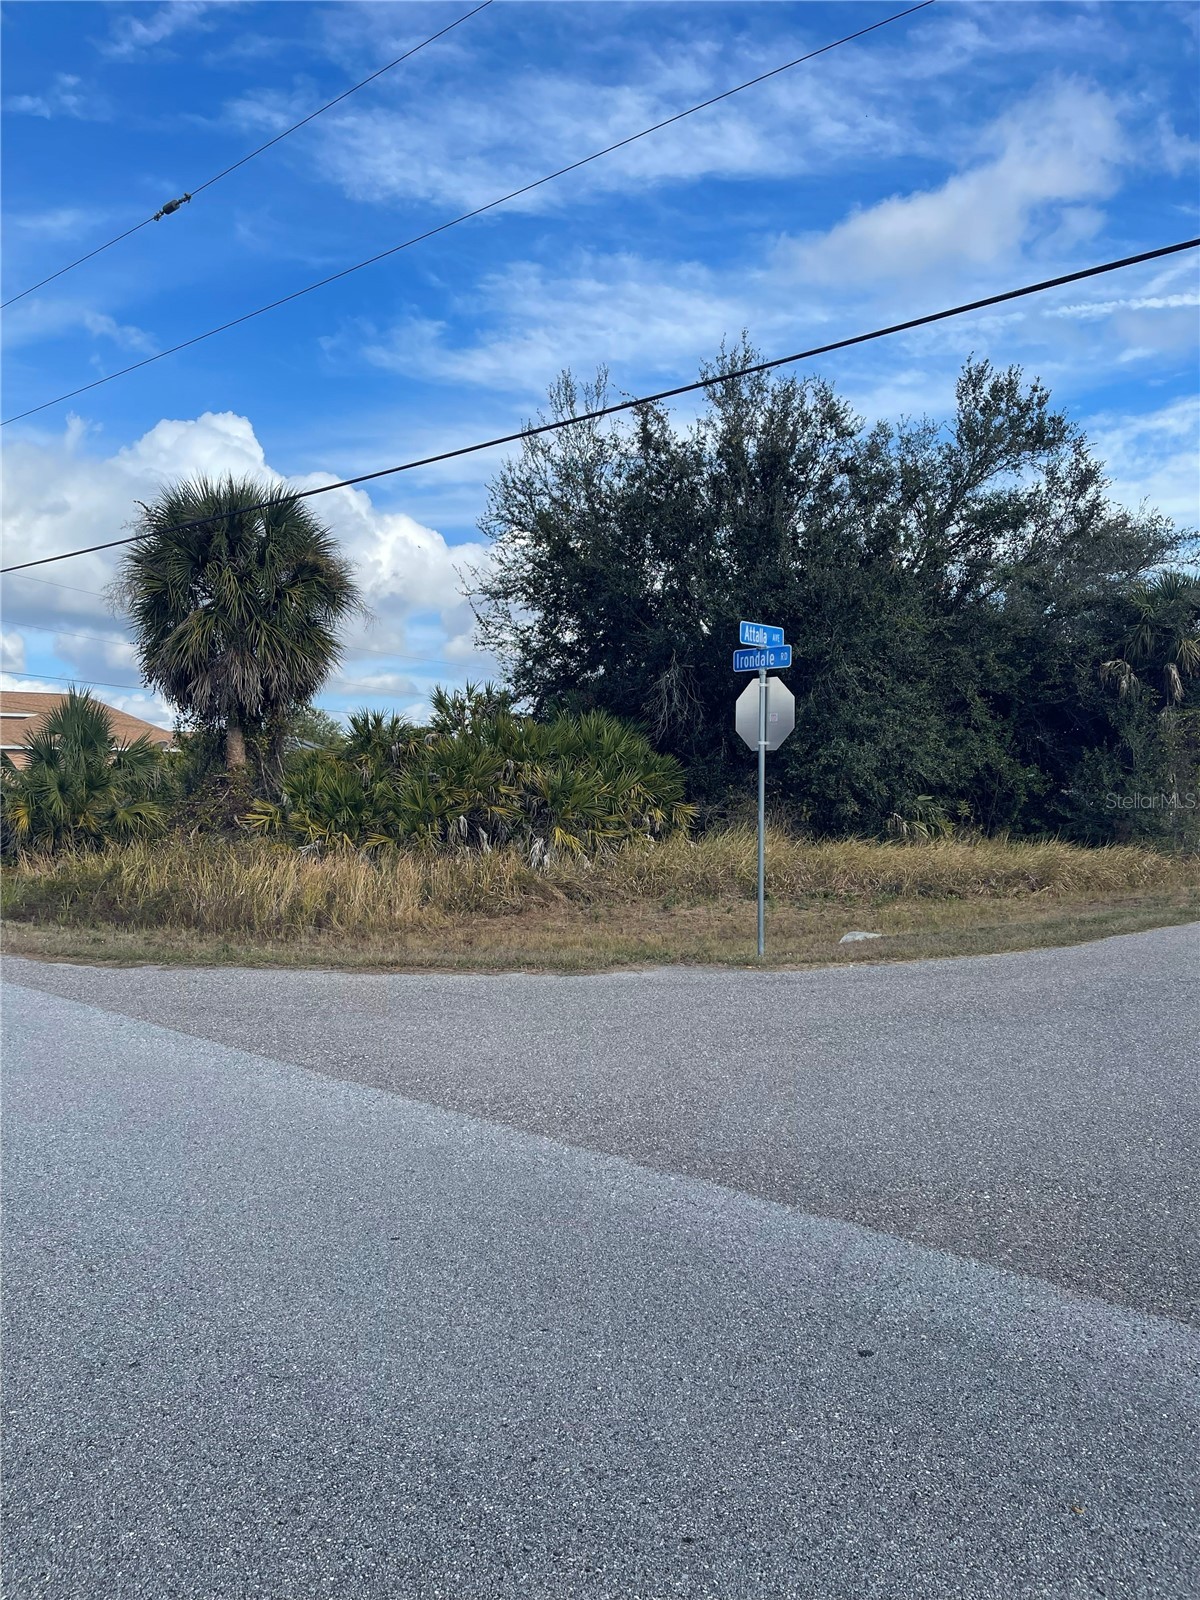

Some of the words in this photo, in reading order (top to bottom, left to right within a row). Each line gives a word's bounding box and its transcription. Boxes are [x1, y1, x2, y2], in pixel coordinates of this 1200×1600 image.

[744, 625, 767, 644] Attalla
[736, 650, 775, 669] Irondale
[780, 652, 788, 661] RD
